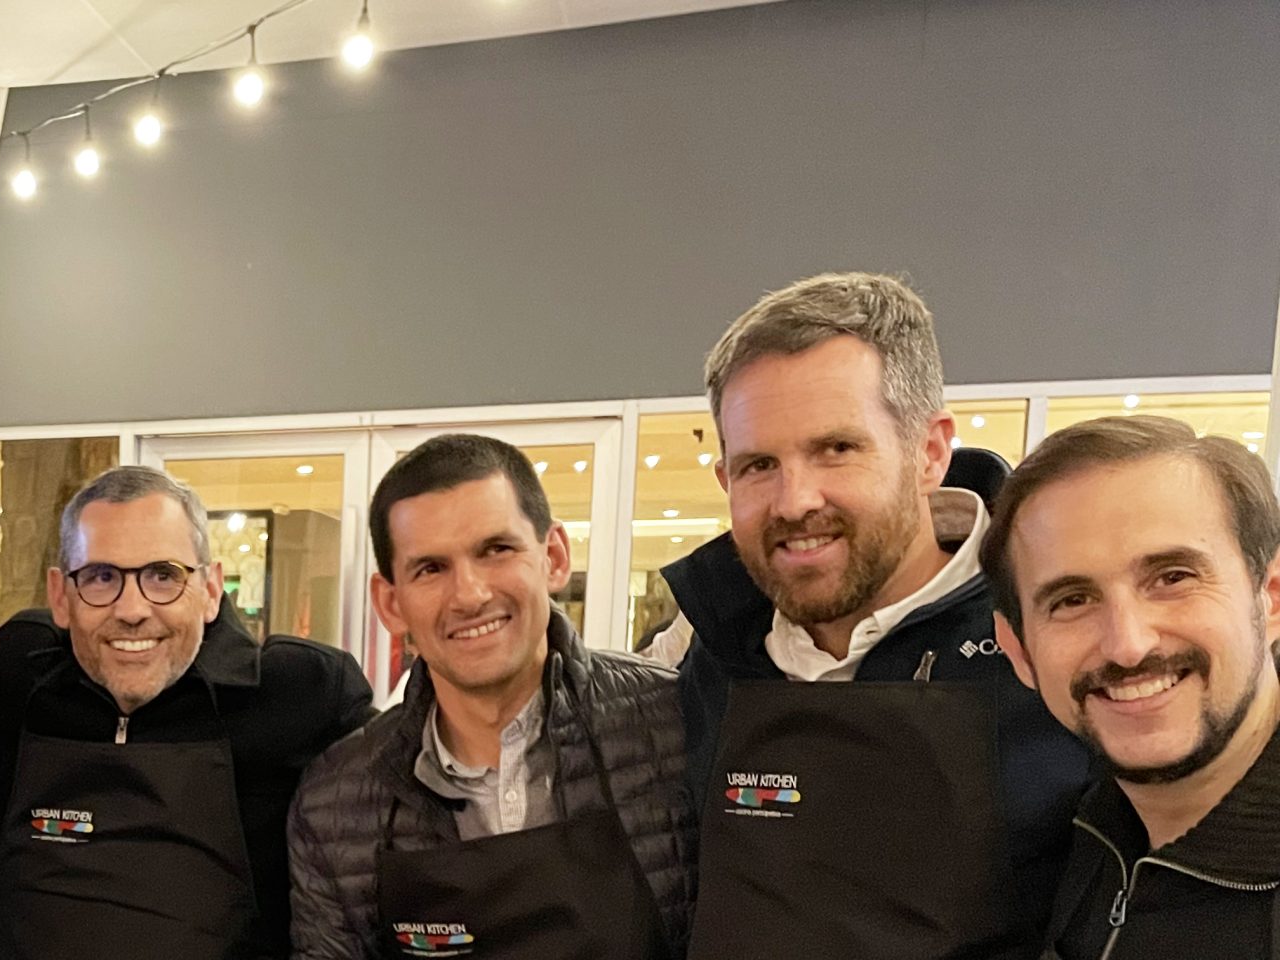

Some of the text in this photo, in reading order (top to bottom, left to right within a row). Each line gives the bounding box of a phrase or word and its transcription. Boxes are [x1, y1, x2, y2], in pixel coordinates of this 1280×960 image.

[726, 772, 798, 789] URBAN KITCHEN
[31, 808, 93, 822] URBAN KITCHEN
[392, 922, 467, 935] URBAN KITCHEN
